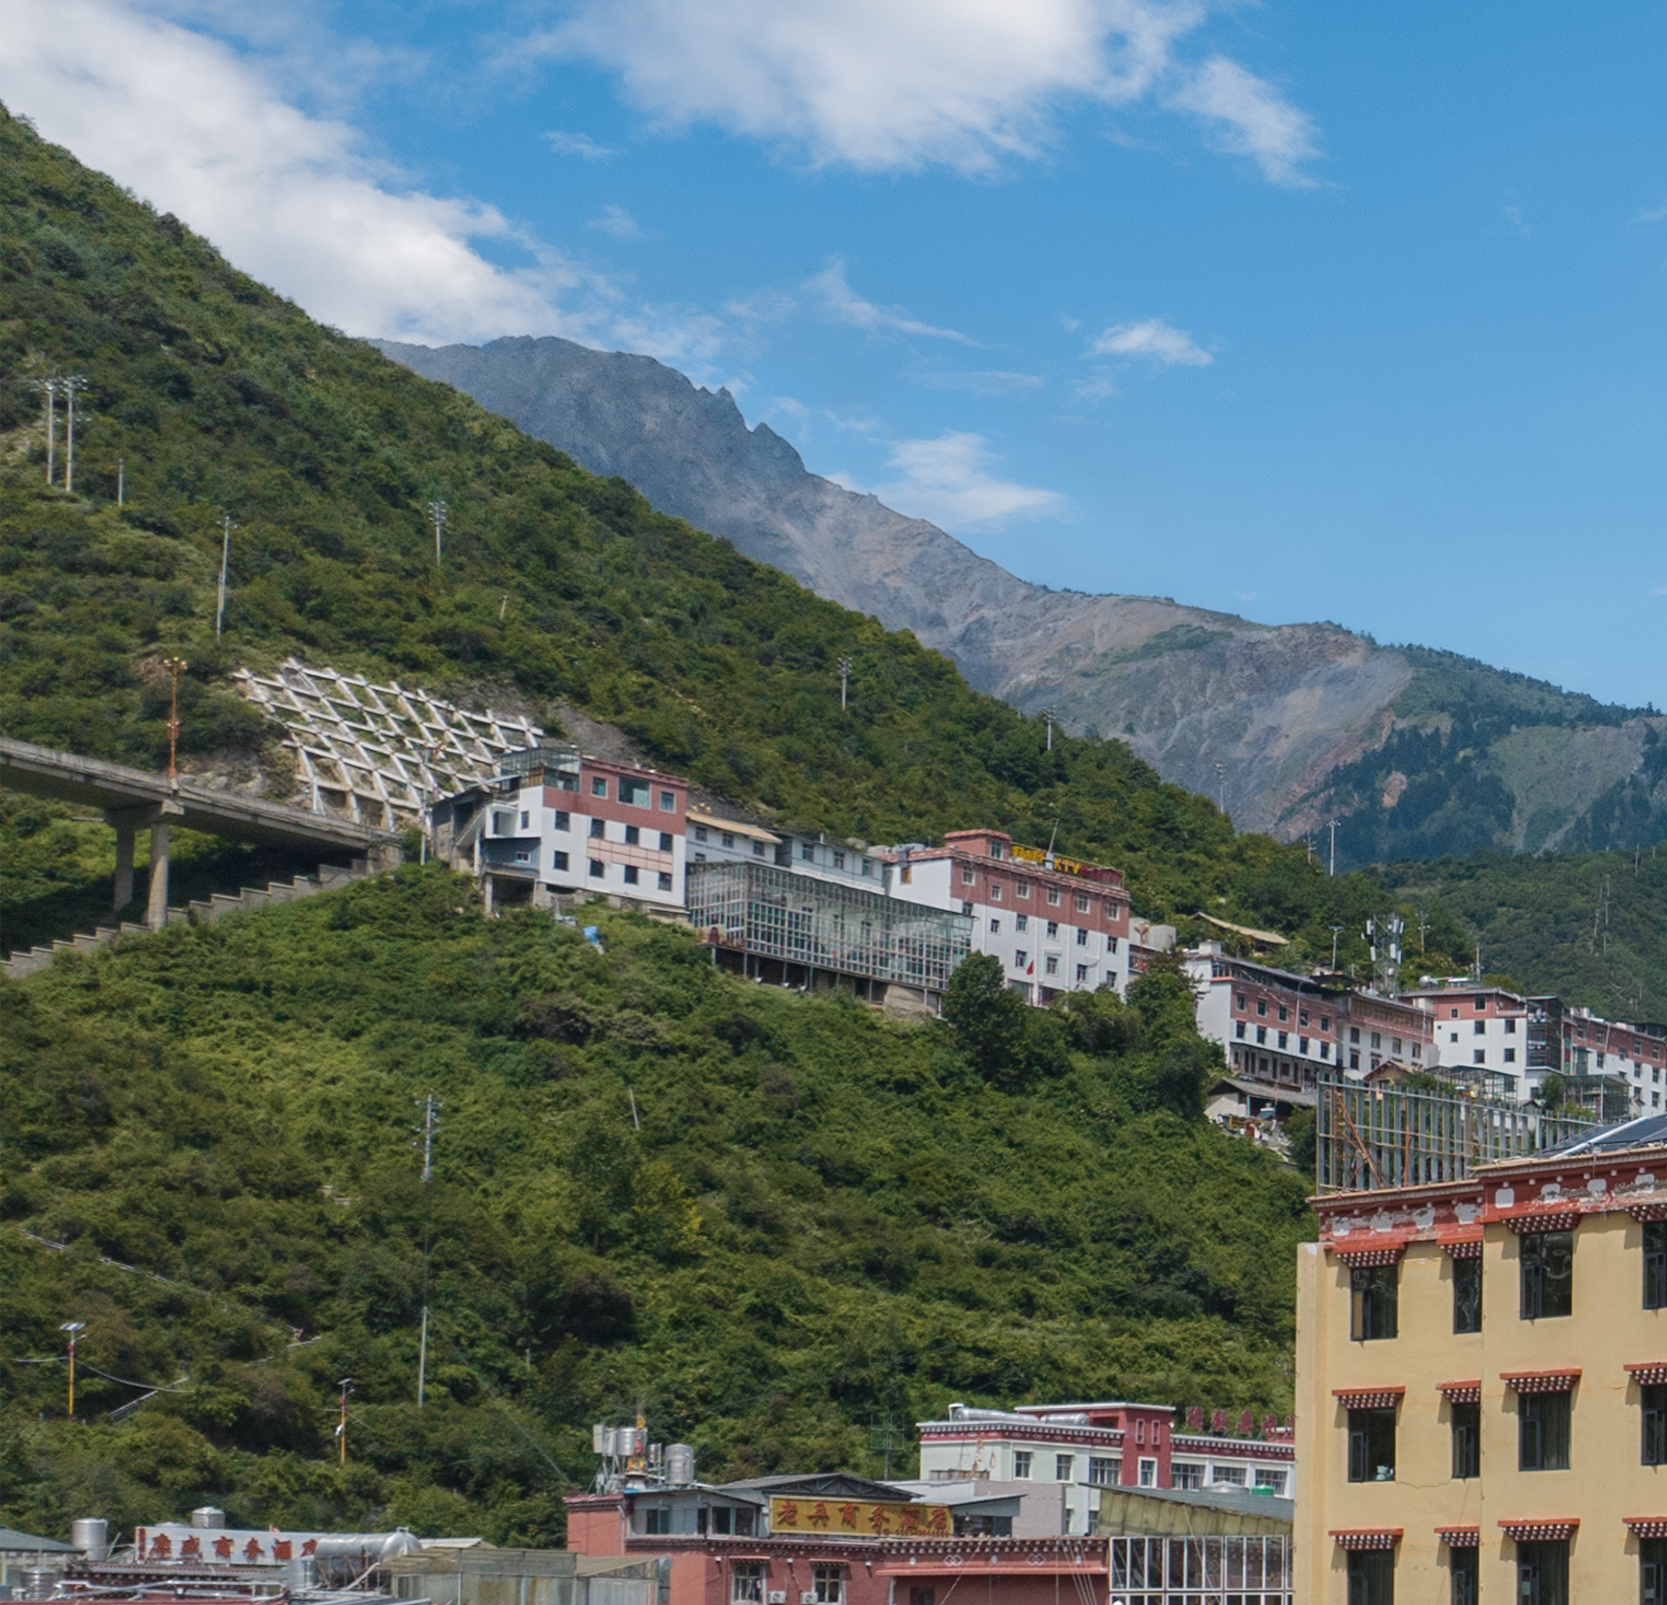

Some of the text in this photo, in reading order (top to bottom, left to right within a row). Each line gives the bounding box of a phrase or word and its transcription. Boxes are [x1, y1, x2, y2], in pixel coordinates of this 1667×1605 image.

[1053, 857, 1081, 875] KTV
[776, 1500, 948, 1530] 老兵商务酒店
